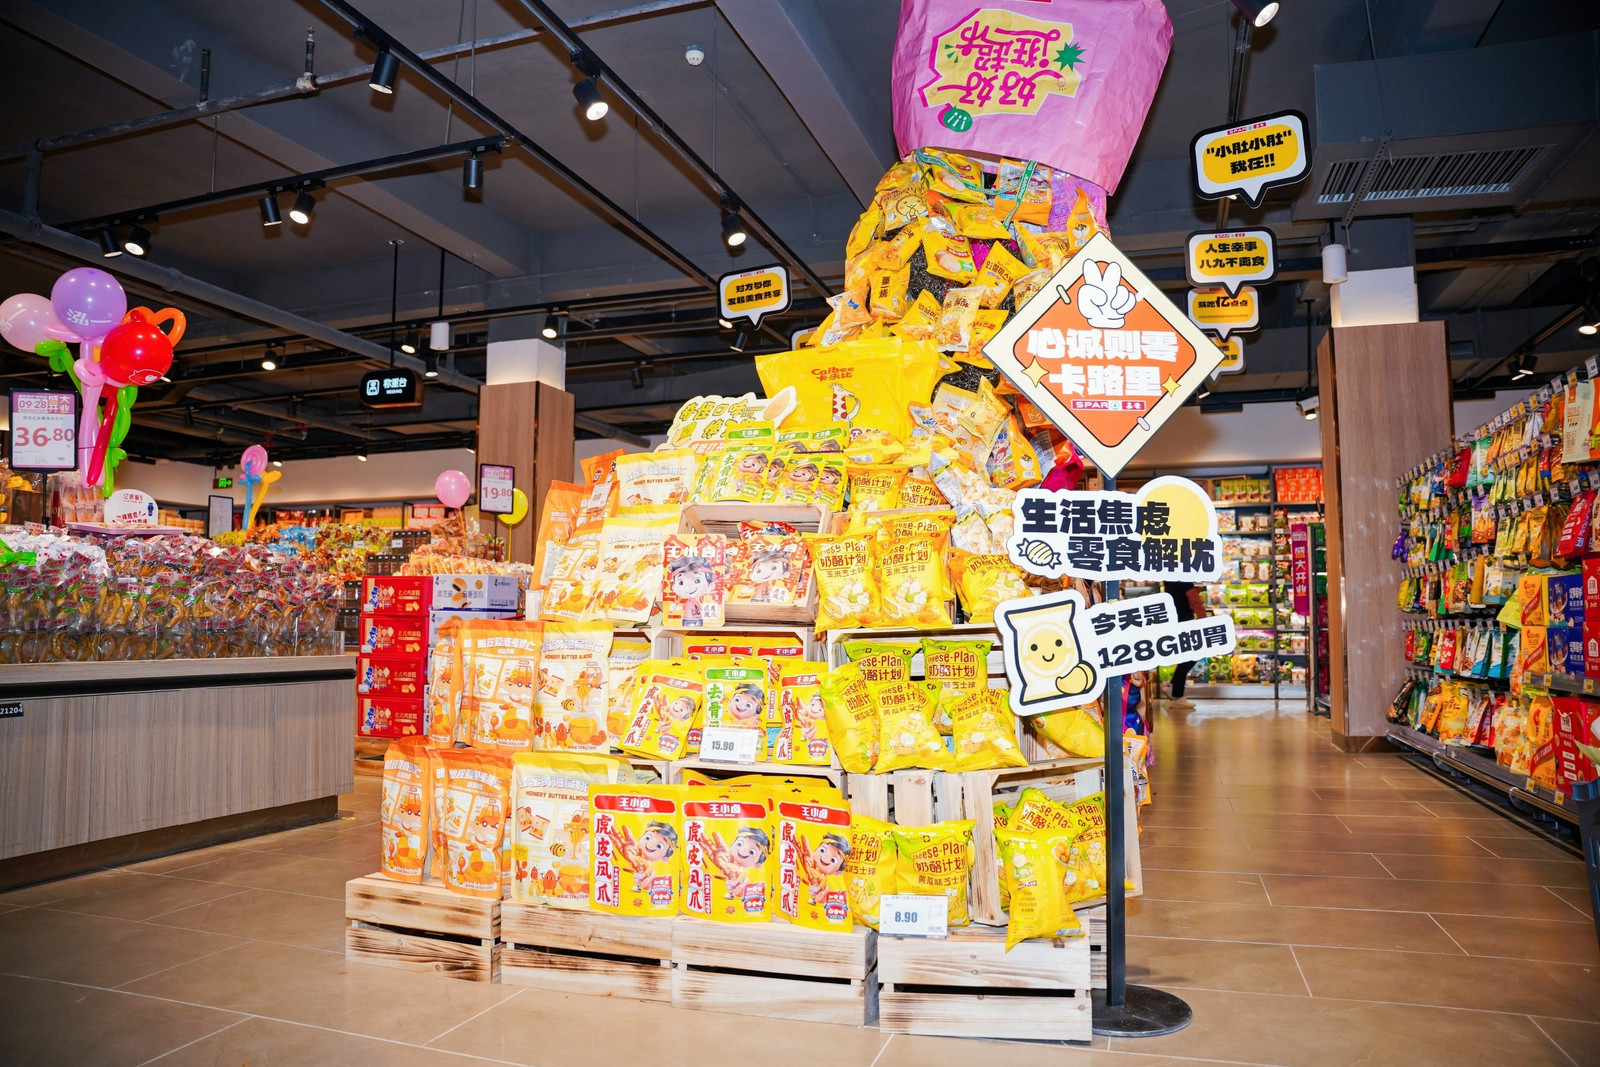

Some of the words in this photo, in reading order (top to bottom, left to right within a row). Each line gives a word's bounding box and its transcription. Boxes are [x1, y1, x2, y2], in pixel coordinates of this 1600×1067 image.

[1205, 241, 1258, 254] 人生幸事
[1026, 327, 1179, 363] 心诚则零
[811, 367, 855, 376] Calbee
[815, 373, 853, 382] 卡乐比
[1049, 363, 1163, 398] 卡路里
[1075, 401, 1110, 409] SPAR
[14, 426, 75, 448] 36.80
[483, 486, 513, 499] 19.80
[1021, 498, 1172, 536] 生活焦虑
[820, 554, 867, 567] 奶酪计划
[882, 550, 929, 567] 奶酪计划
[1066, 535, 1216, 573] 零食解忧
[1295, 546, 1307, 597] 盛大开业
[1090, 602, 1169, 636] 今天是
[1097, 624, 1228, 669] 128G的胃
[724, 669, 747, 678] 王小卤
[624, 685, 660, 746] 虎皮凤爪
[776, 689, 793, 760] 虎皮凤爪
[711, 740, 735, 751] 15.90
[619, 797, 651, 808] 王小卤
[709, 803, 741, 814] 王小卤
[801, 806, 829, 819] 王小卤
[595, 814, 612, 903] 虎皮凤爪
[687, 821, 703, 911] 虎皮凤爪
[781, 821, 796, 913] 虎皮凤爪
[916, 858, 965, 873] 奶酪计划
[895, 911, 918, 923] 8.90
